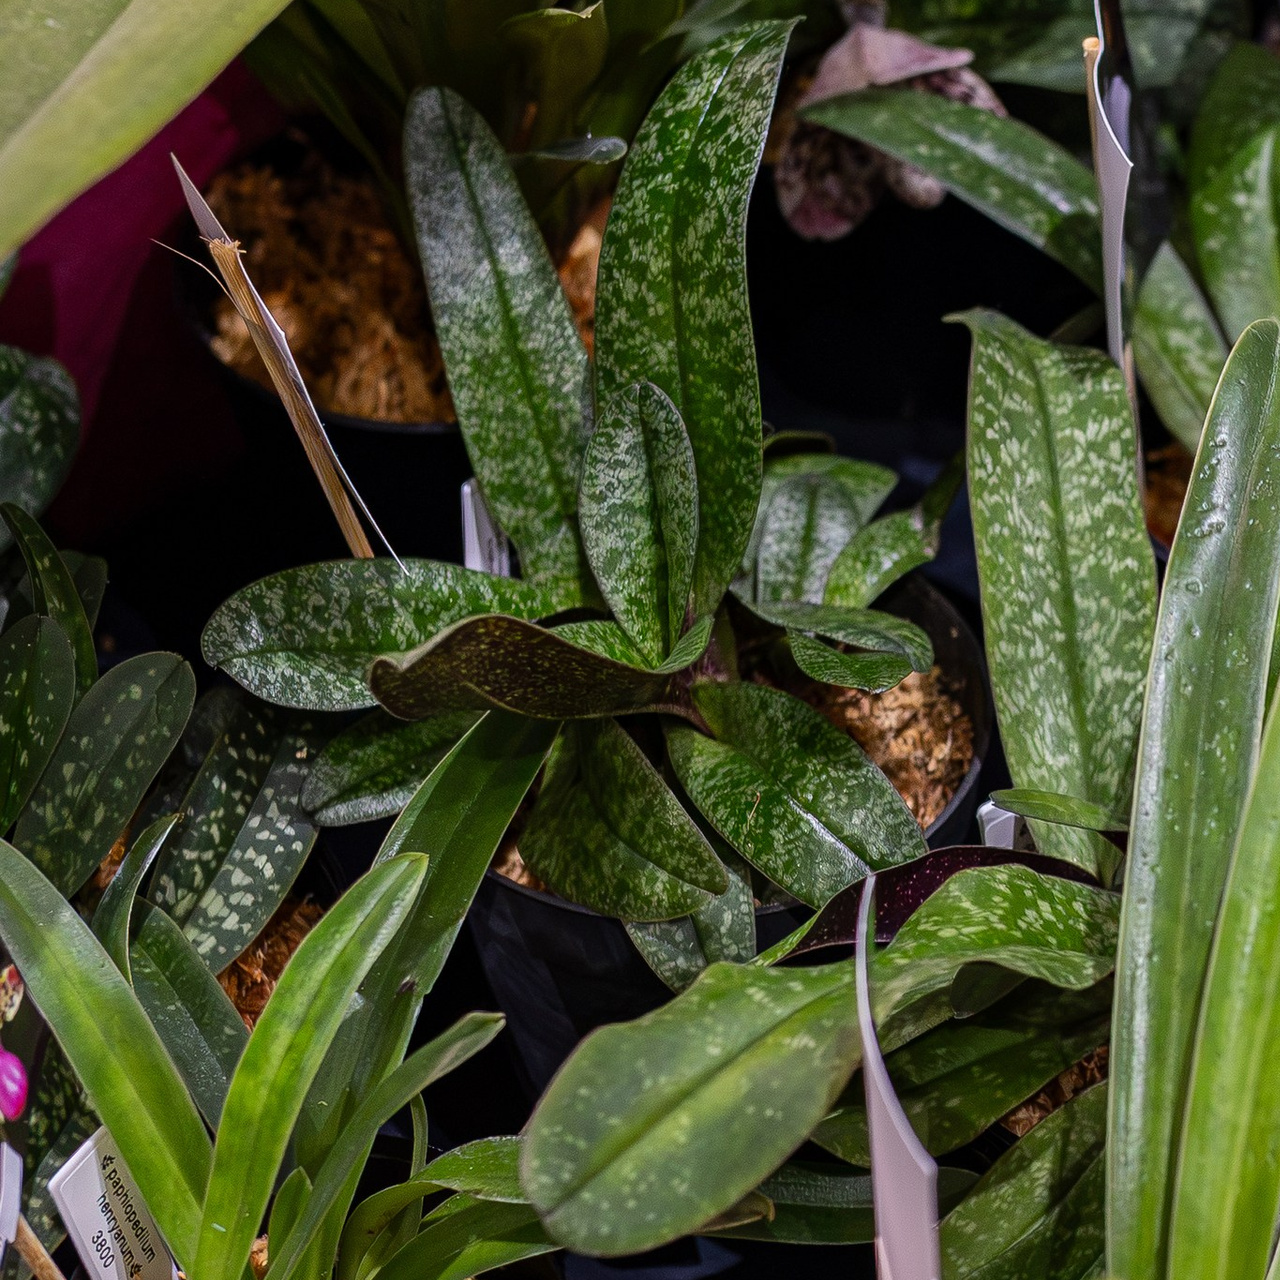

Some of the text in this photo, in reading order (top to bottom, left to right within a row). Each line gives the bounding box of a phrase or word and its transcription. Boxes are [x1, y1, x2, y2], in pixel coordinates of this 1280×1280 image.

[91, 1229, 116, 1268] 3800
[96, 1188, 136, 1266] henryanum
[104, 1167, 157, 1264] paphiopedilum
